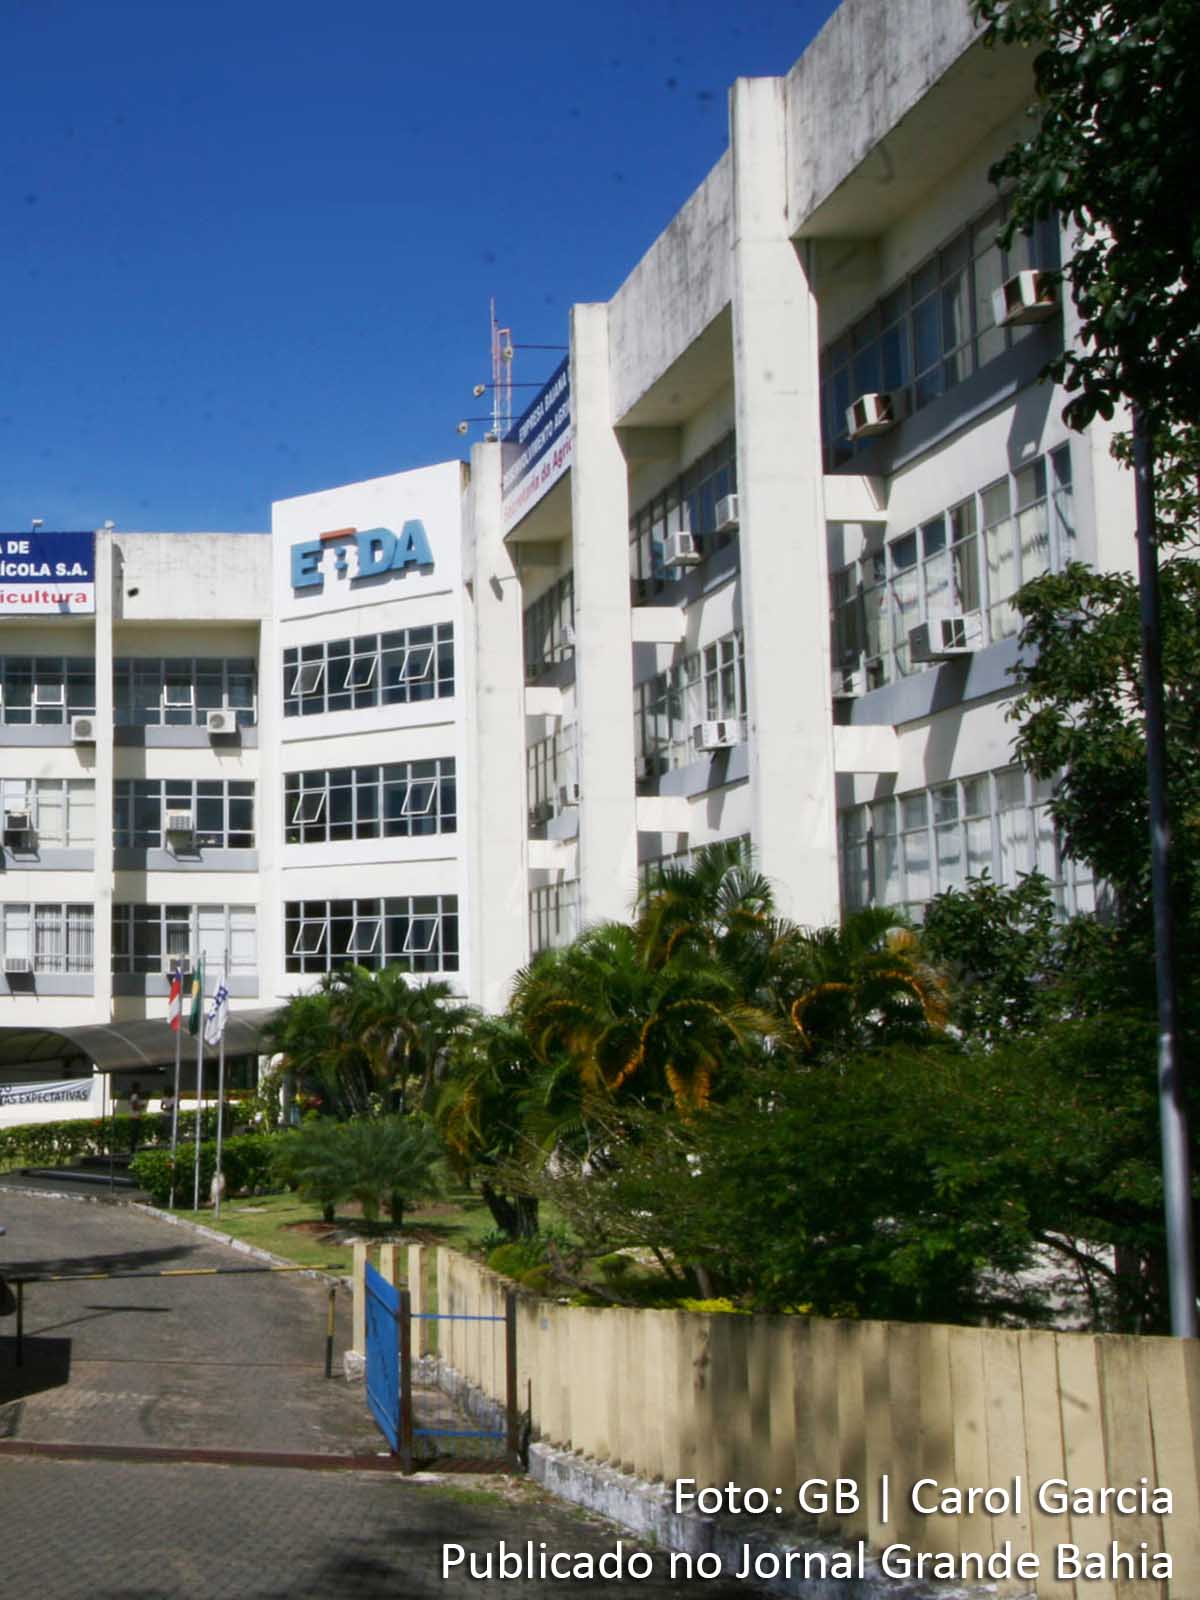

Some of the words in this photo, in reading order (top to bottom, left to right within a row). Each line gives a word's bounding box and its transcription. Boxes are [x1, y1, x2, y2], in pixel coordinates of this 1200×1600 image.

[7, 540, 29, 554] DE
[56, 562, 88, 576] S.A.
[19, 1088, 89, 1104] EXPECTATIVAS
